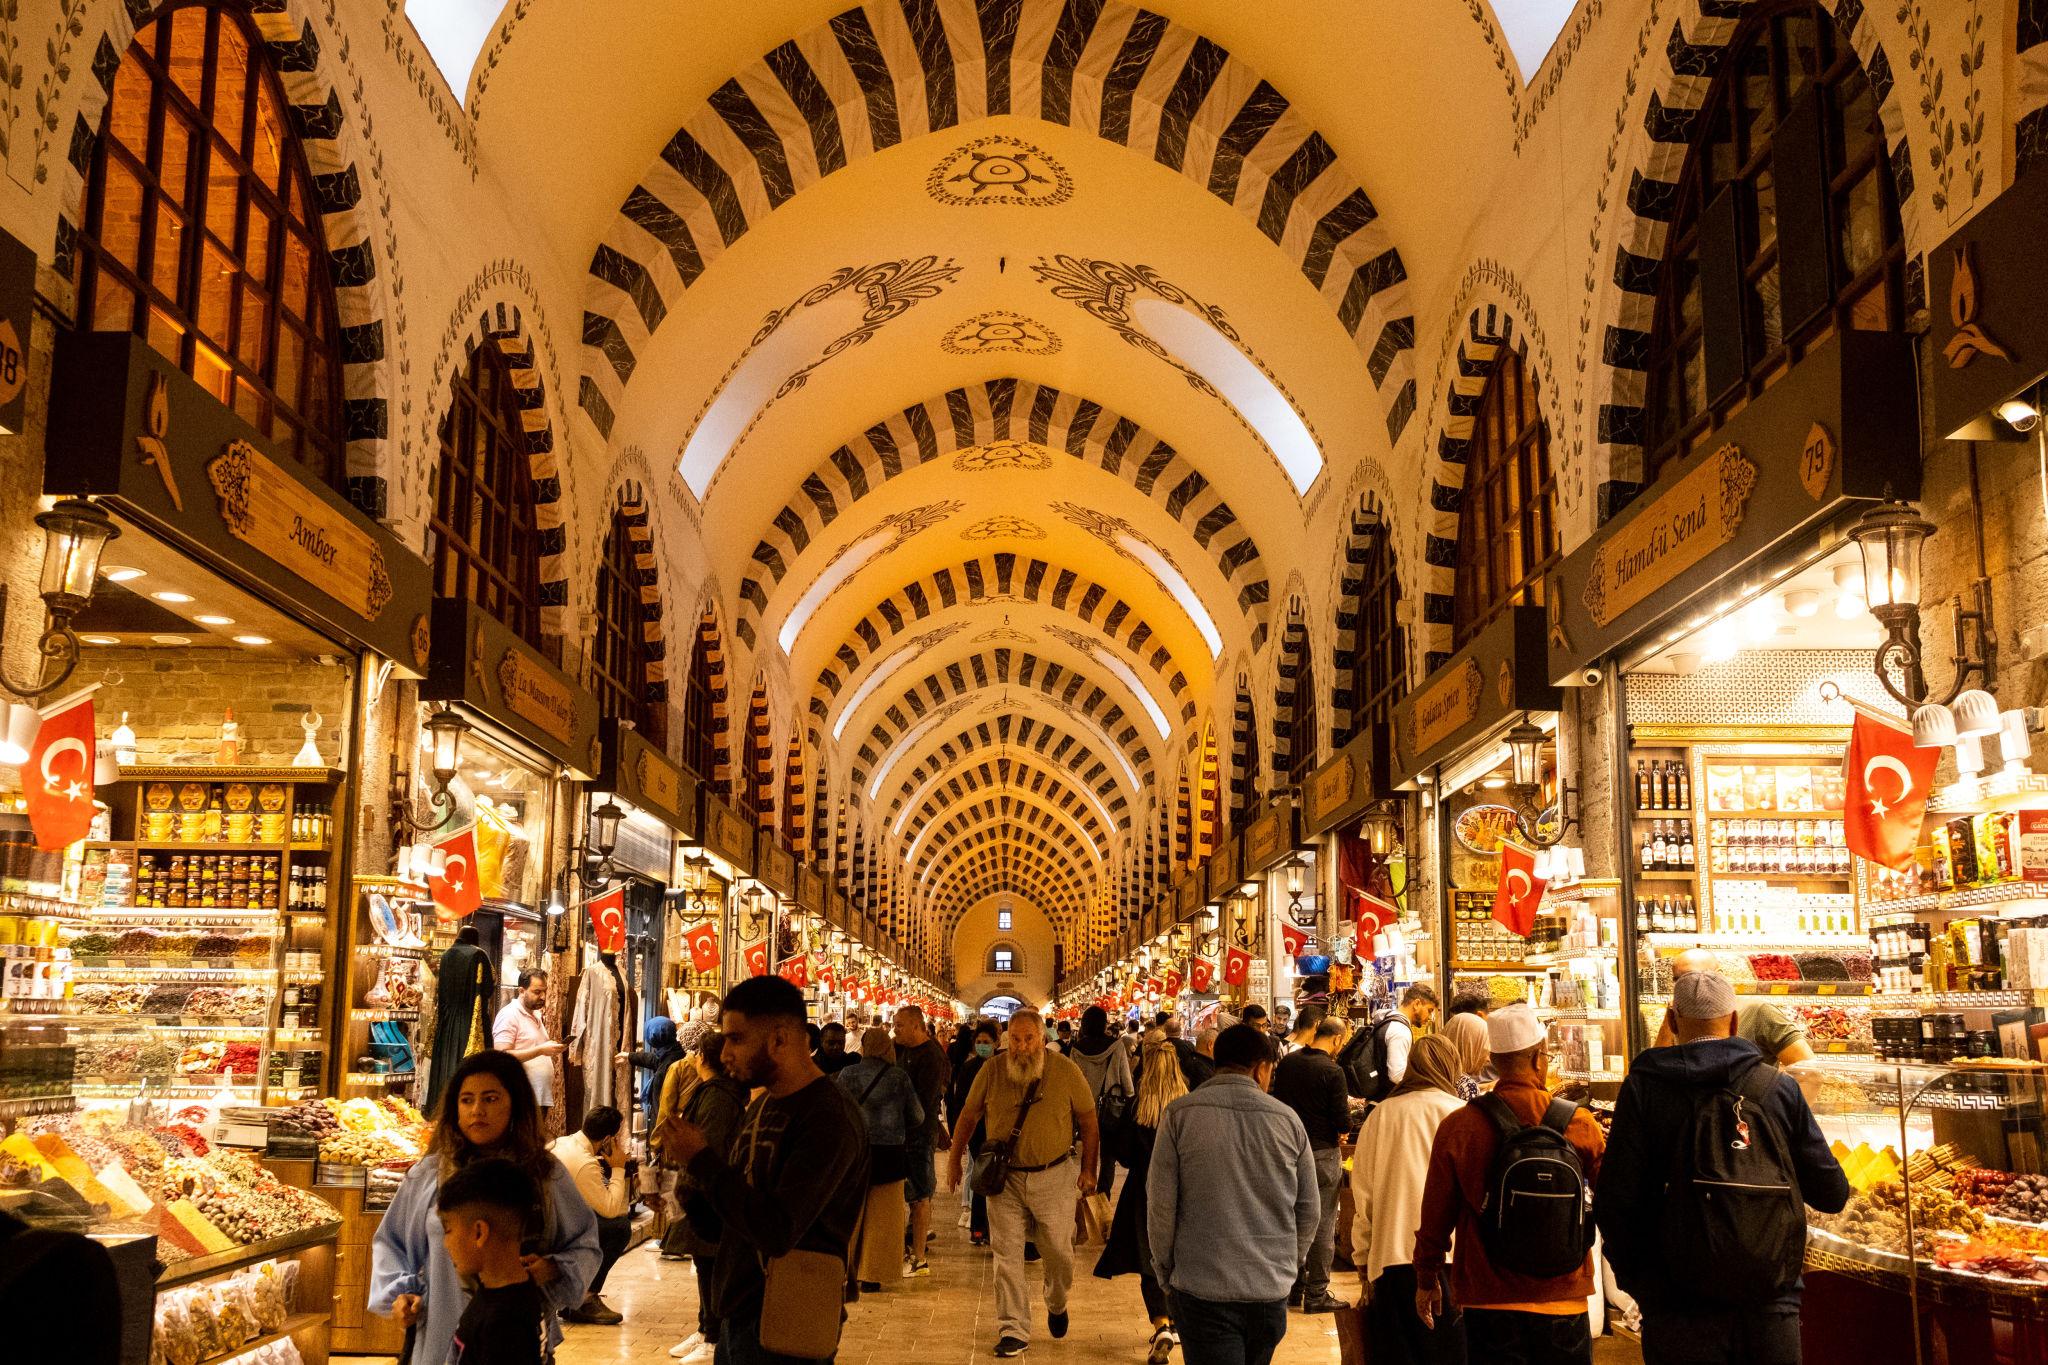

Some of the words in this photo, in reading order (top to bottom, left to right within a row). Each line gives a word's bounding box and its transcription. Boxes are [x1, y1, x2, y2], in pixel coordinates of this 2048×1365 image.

[0, 340, 17, 385] 8
[1805, 439, 1824, 482] 79
[289, 515, 338, 566] Amber
[1614, 522, 1669, 590] Hamd-ü
[1671, 493, 1708, 549] Senâ
